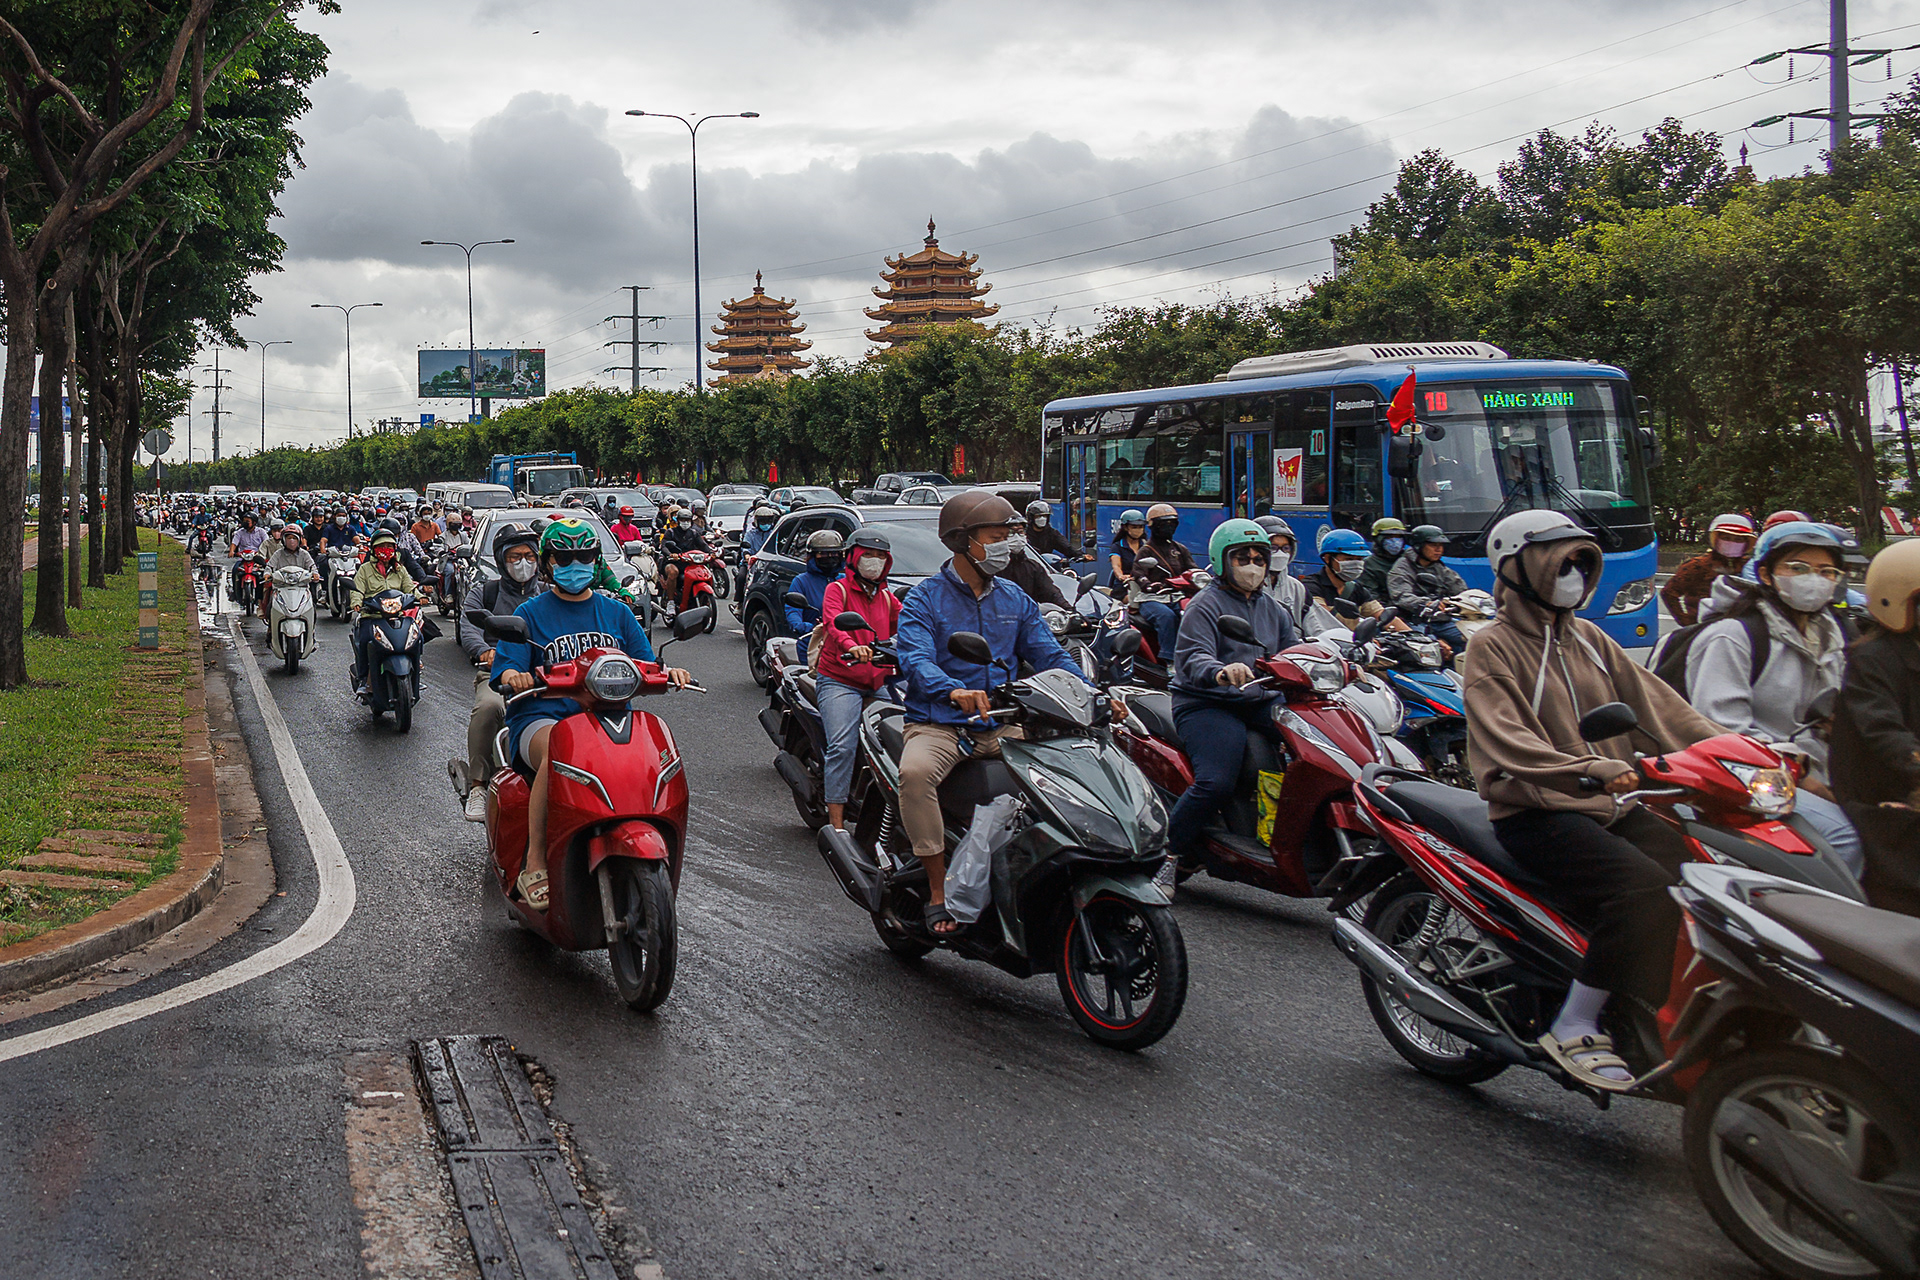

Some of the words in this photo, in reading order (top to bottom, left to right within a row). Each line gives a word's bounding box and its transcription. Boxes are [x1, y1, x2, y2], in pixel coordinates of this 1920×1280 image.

[1335, 399, 1375, 411] SaigonBus
[1424, 391, 1447, 412] 10
[1483, 391, 1527, 408] HÀNG
[1531, 392, 1574, 406] XANH
[1312, 432, 1324, 453] 10
